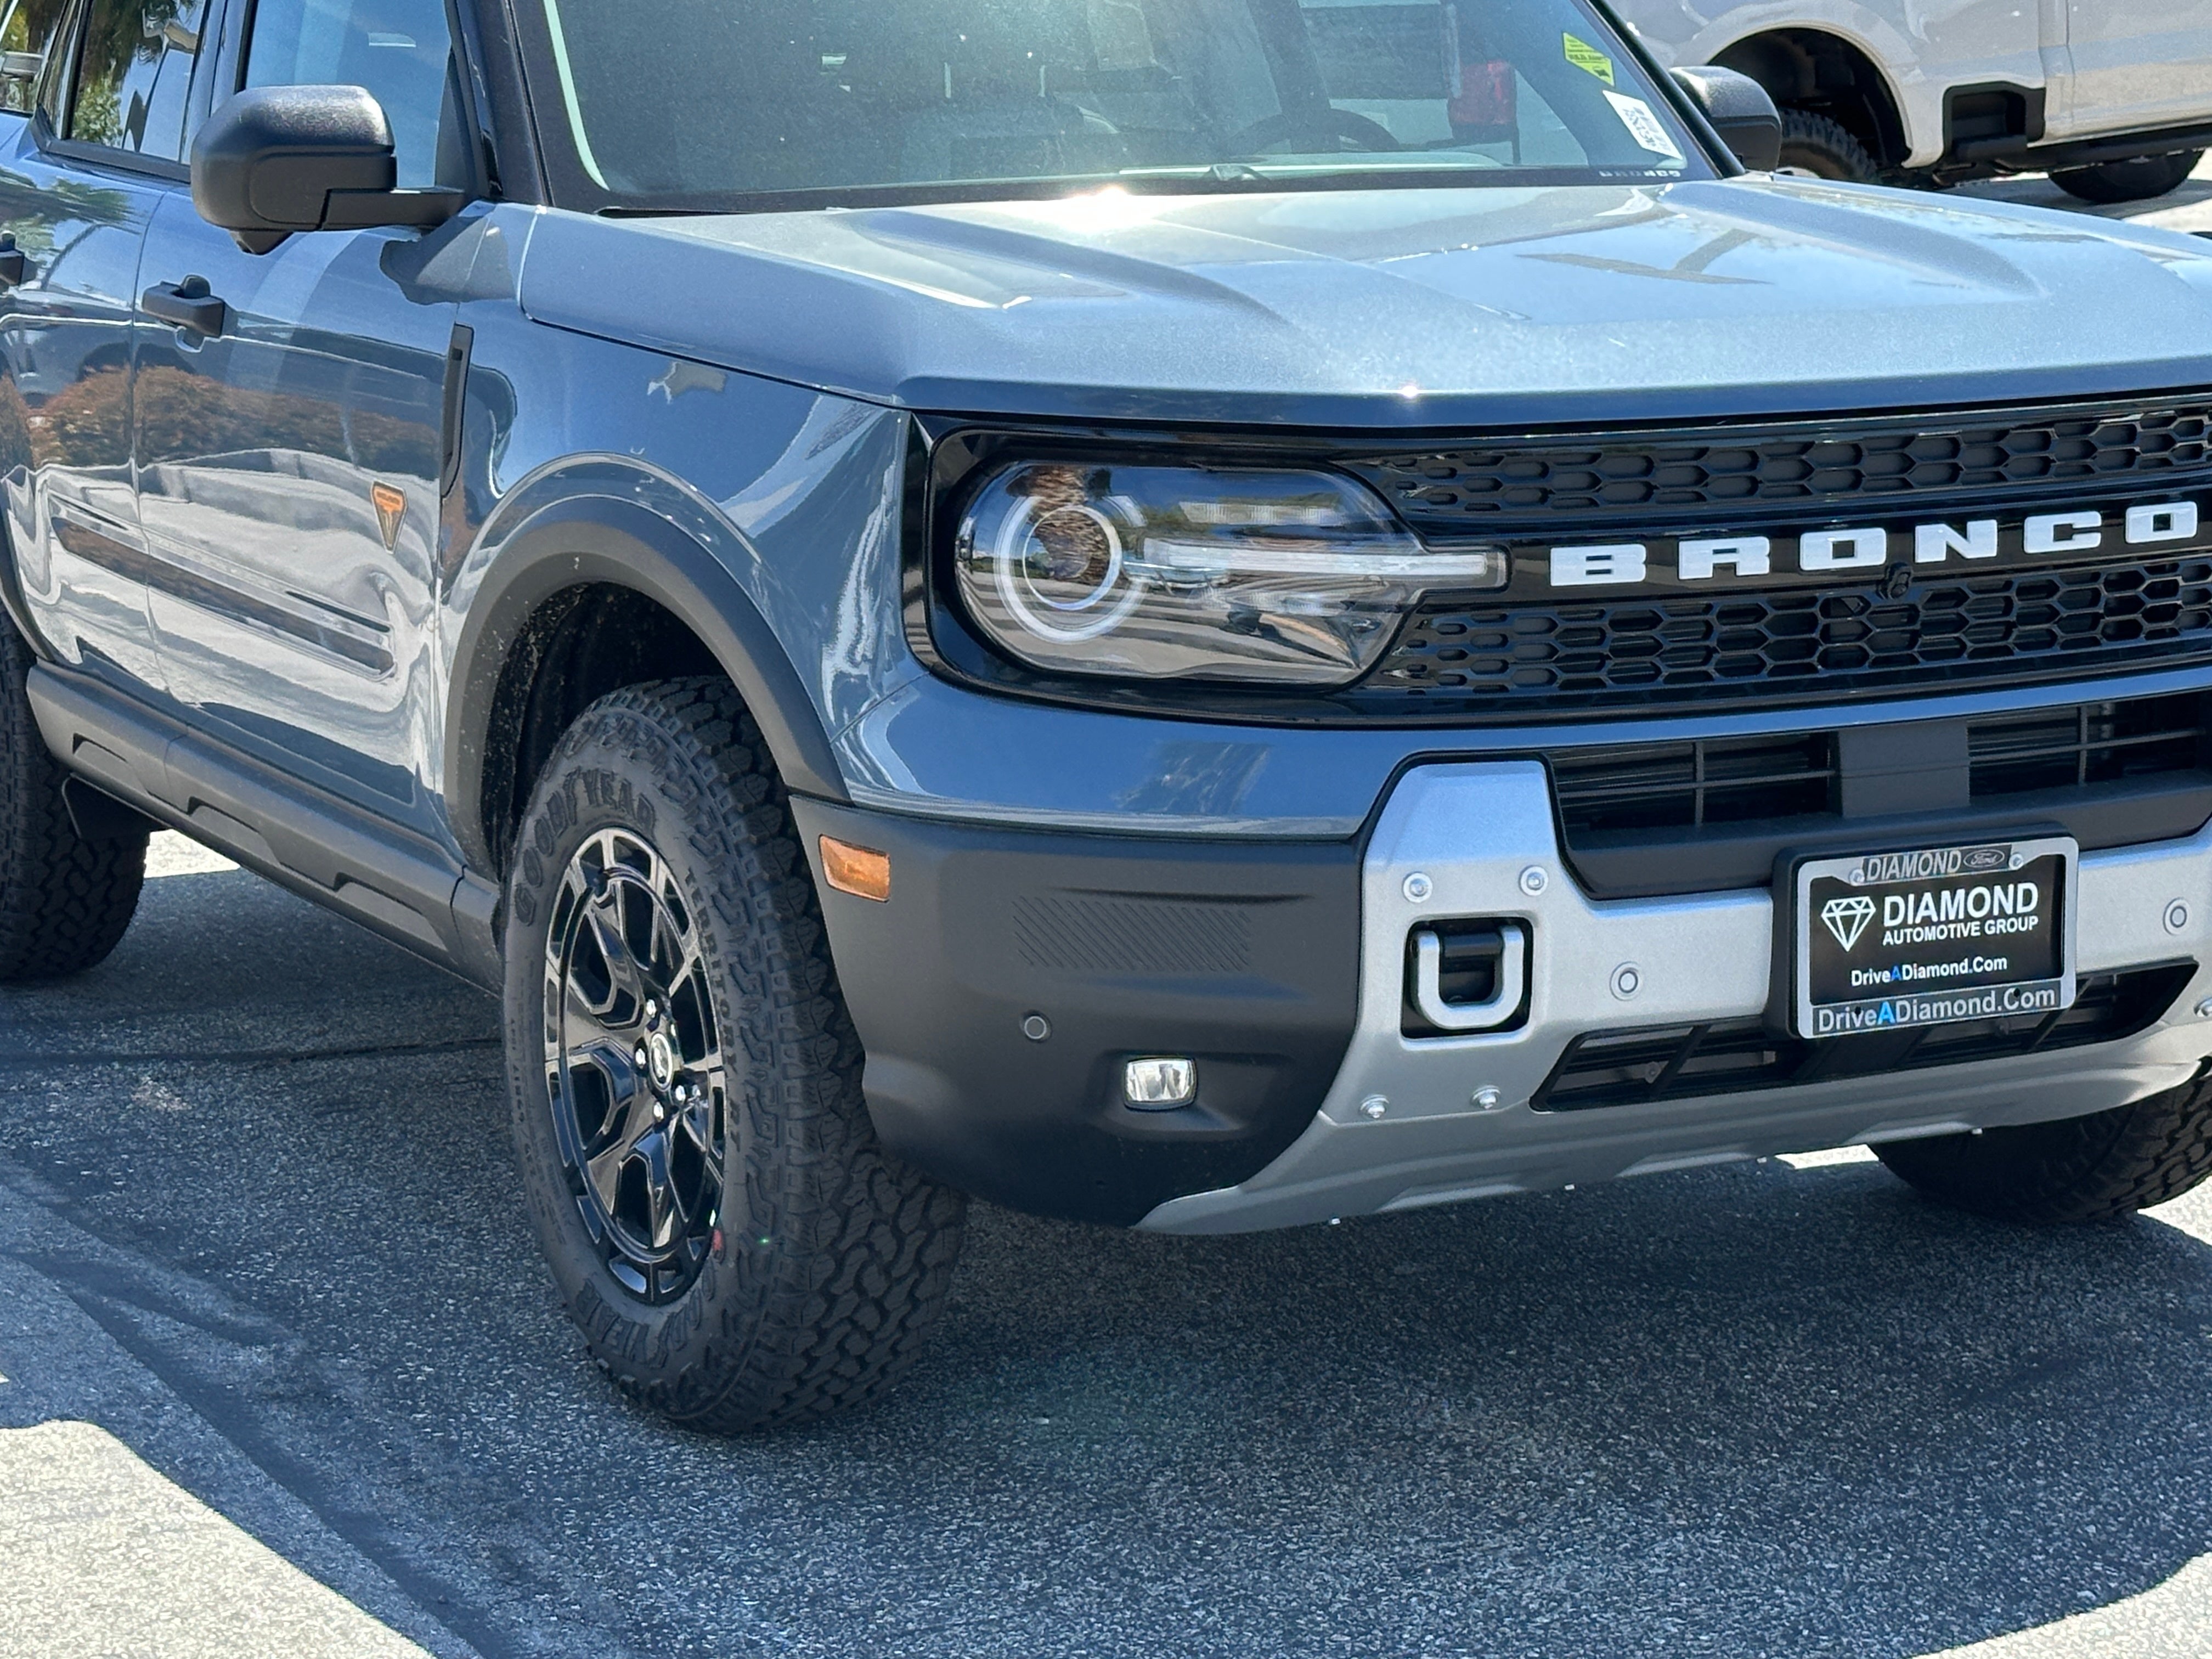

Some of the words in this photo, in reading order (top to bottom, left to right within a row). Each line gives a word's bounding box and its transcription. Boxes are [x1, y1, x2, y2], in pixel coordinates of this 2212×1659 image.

[1550, 501, 2197, 586] BRONCO
[1867, 850, 1961, 881] DIAMOND
[1883, 882, 2039, 927] DIAMOND
[1882, 921, 1981, 946] AUTOMOTIVE
[1984, 915, 2039, 935] GROUP
[1851, 956, 2007, 987] DriveADiamond.Com
[1818, 988, 2056, 1032] DriveADiamond.Com
